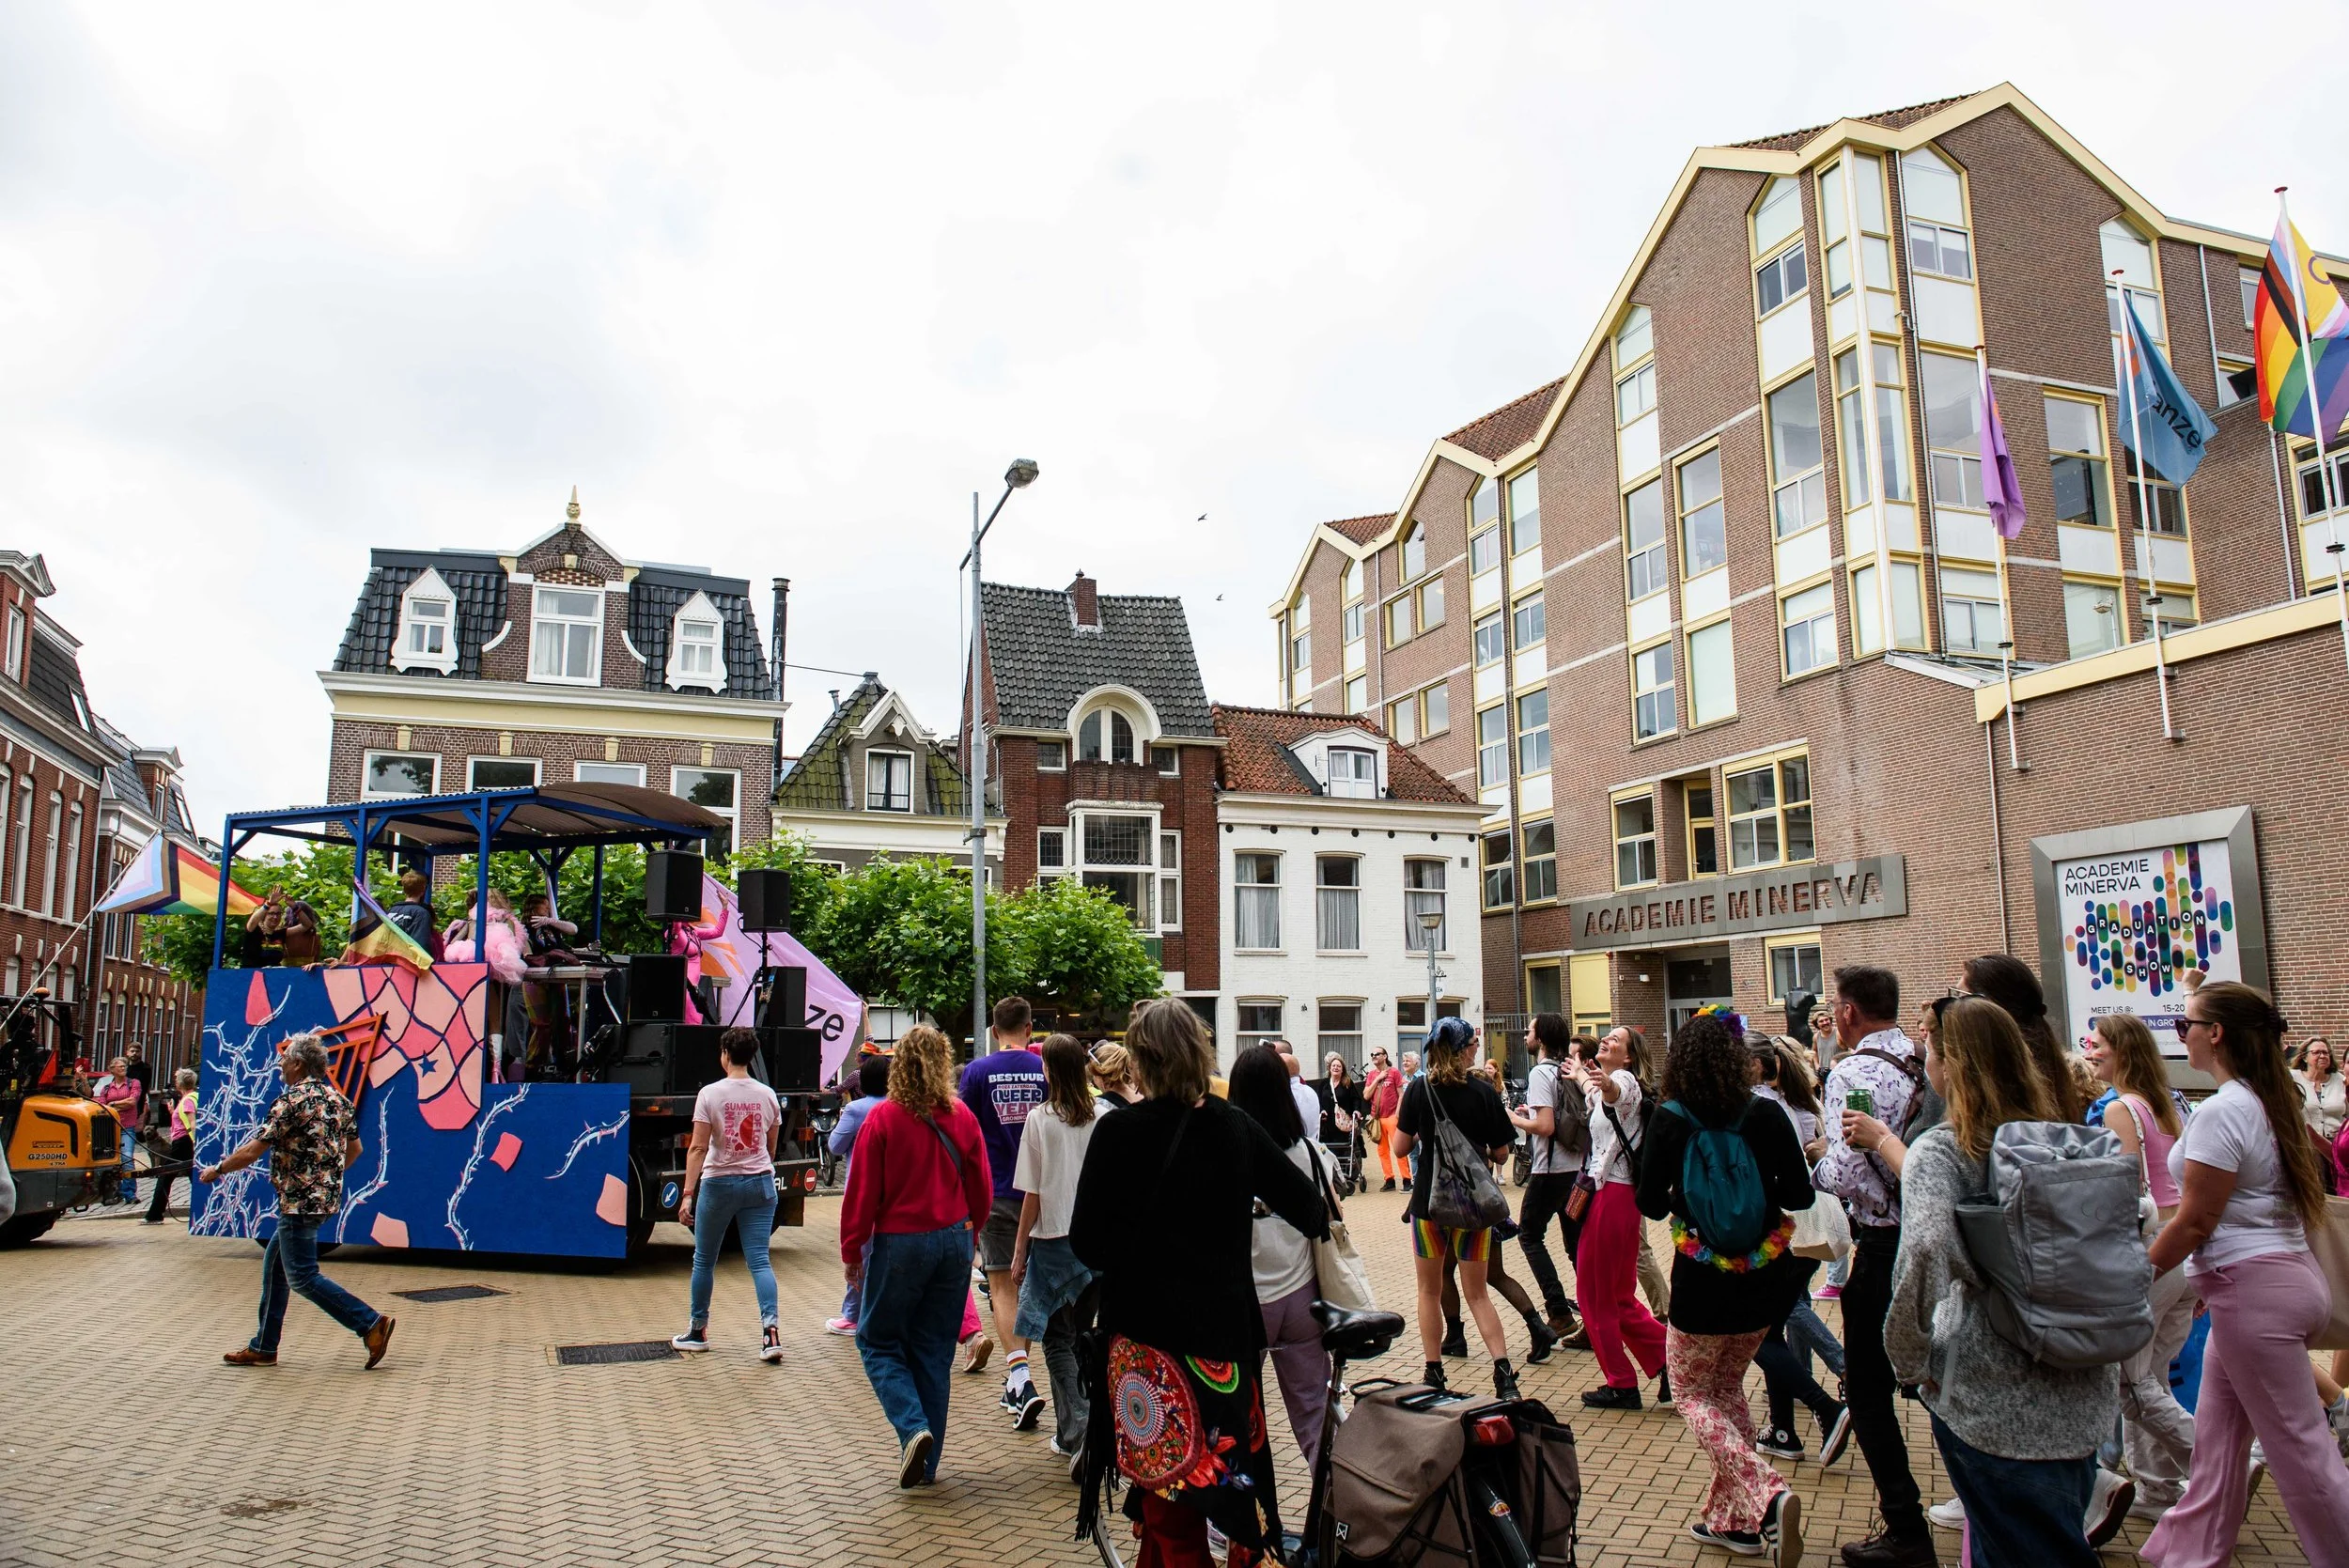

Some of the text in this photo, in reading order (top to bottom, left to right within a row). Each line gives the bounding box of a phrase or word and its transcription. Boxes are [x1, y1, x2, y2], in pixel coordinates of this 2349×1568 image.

[2152, 392, 2201, 448] anze
[2065, 859, 2150, 881] ACADEMIE
[2065, 876, 2141, 897] MINERVA
[1584, 872, 1884, 938] ACADEMIE MINERVA
[2087, 913, 2204, 937] GRADUATION
[2125, 962, 2171, 978] SHOW
[2091, 1006, 2110, 1015] MEET
[2112, 1005, 2123, 1014] US
[2162, 1003, 2186, 1013] 15-20
[804, 1004, 845, 1042] ze
[988, 1073, 1045, 1083] BESTUUR
[724, 1102, 761, 1110] SUMMER
[992, 1089, 1042, 1103] QUEER
[724, 1110, 735, 1136] SUN
[751, 1112, 762, 1155] OF LOVE
[773, 1176, 788, 1191] AL
